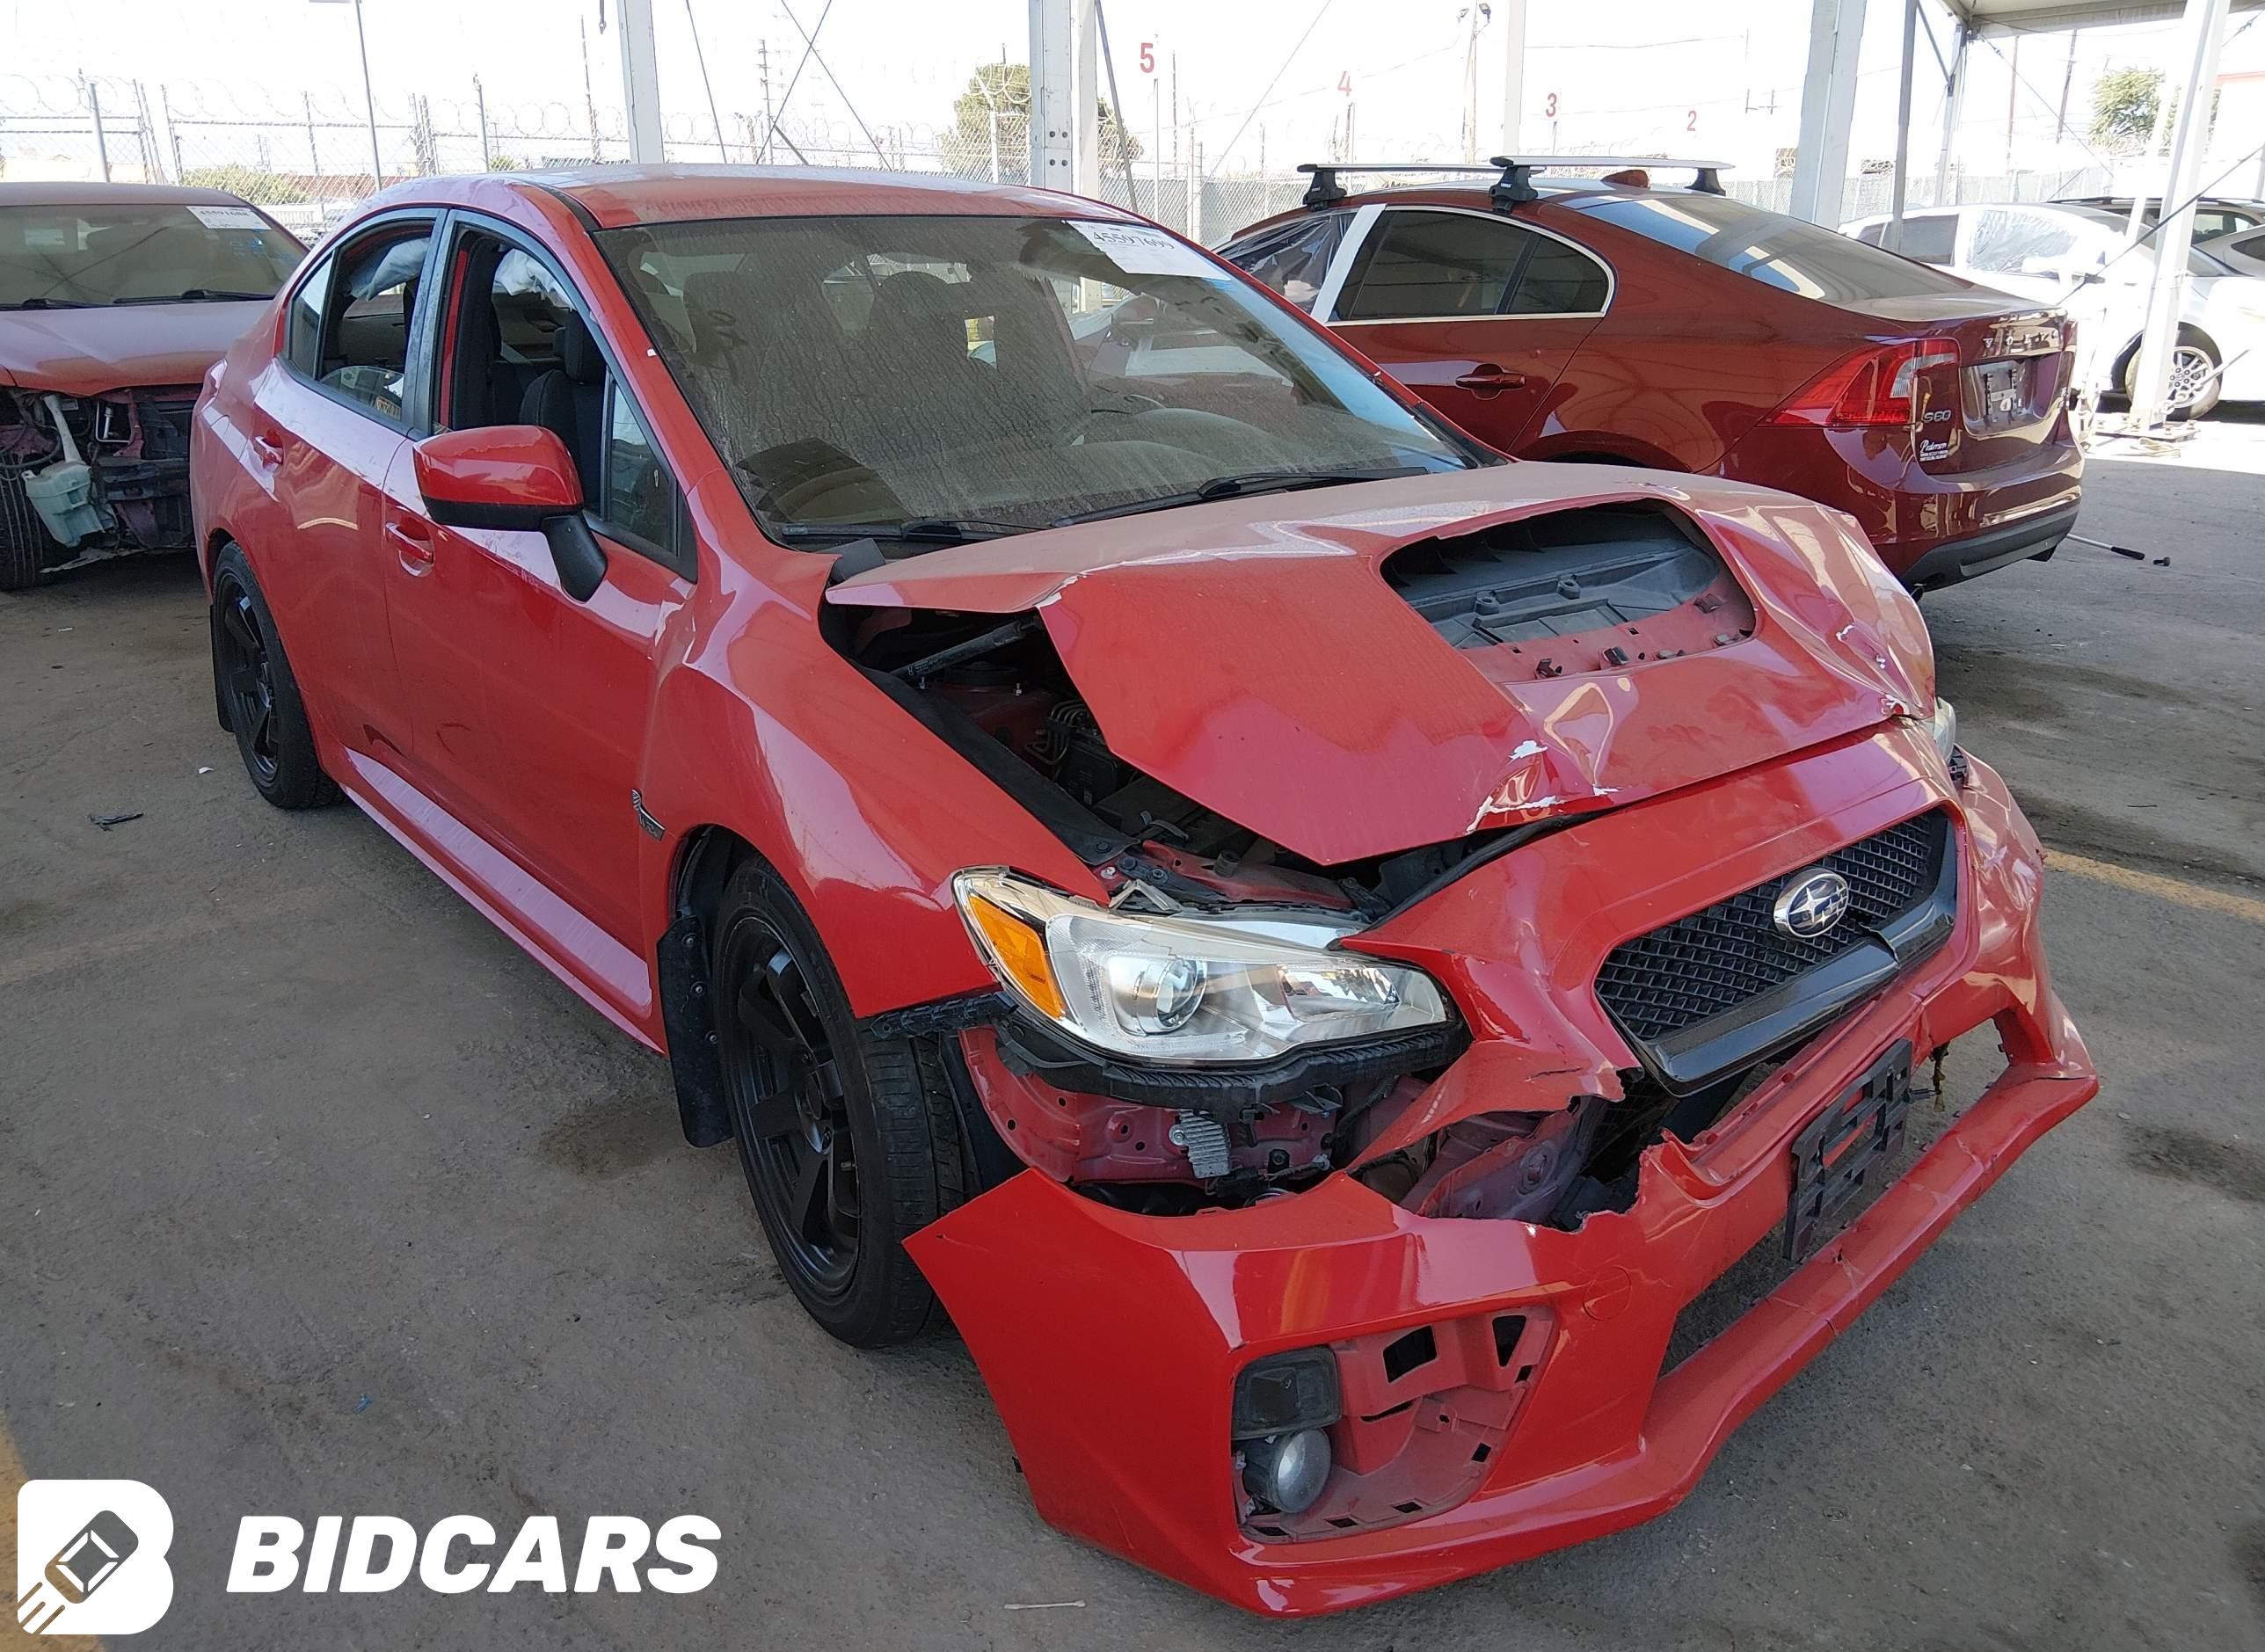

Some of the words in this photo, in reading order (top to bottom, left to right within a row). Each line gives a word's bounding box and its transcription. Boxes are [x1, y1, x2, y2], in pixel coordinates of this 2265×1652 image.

[1140, 42, 1154, 73] 5
[1337, 70, 1352, 97] 4
[1546, 92, 1557, 117] 3
[1686, 110, 1697, 132] 2
[1923, 410, 1951, 422] S60
